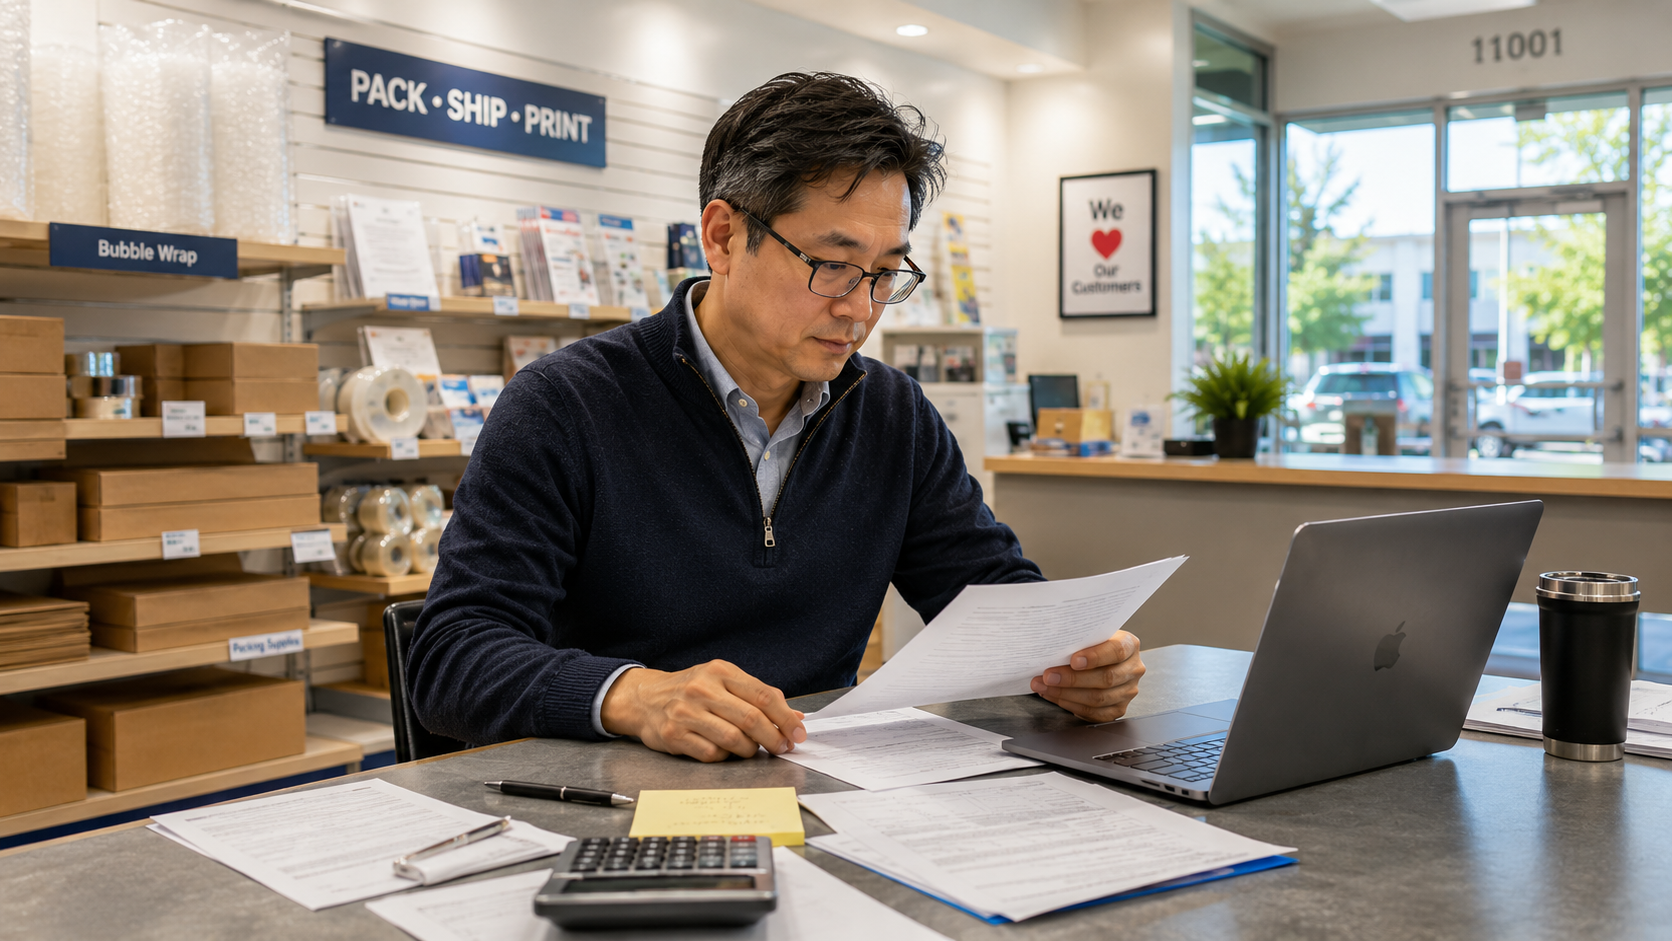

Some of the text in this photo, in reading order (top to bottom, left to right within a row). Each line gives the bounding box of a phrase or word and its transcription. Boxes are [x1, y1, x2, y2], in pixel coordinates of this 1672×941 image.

[1471, 27, 1562, 64] 11001
[351, 68, 592, 144] PACK SHIP PRINT
[1089, 199, 1124, 220] We
[98, 239, 198, 267] Bubble Wrap
[1094, 264, 1119, 278] Our
[1072, 281, 1142, 295] Customers
